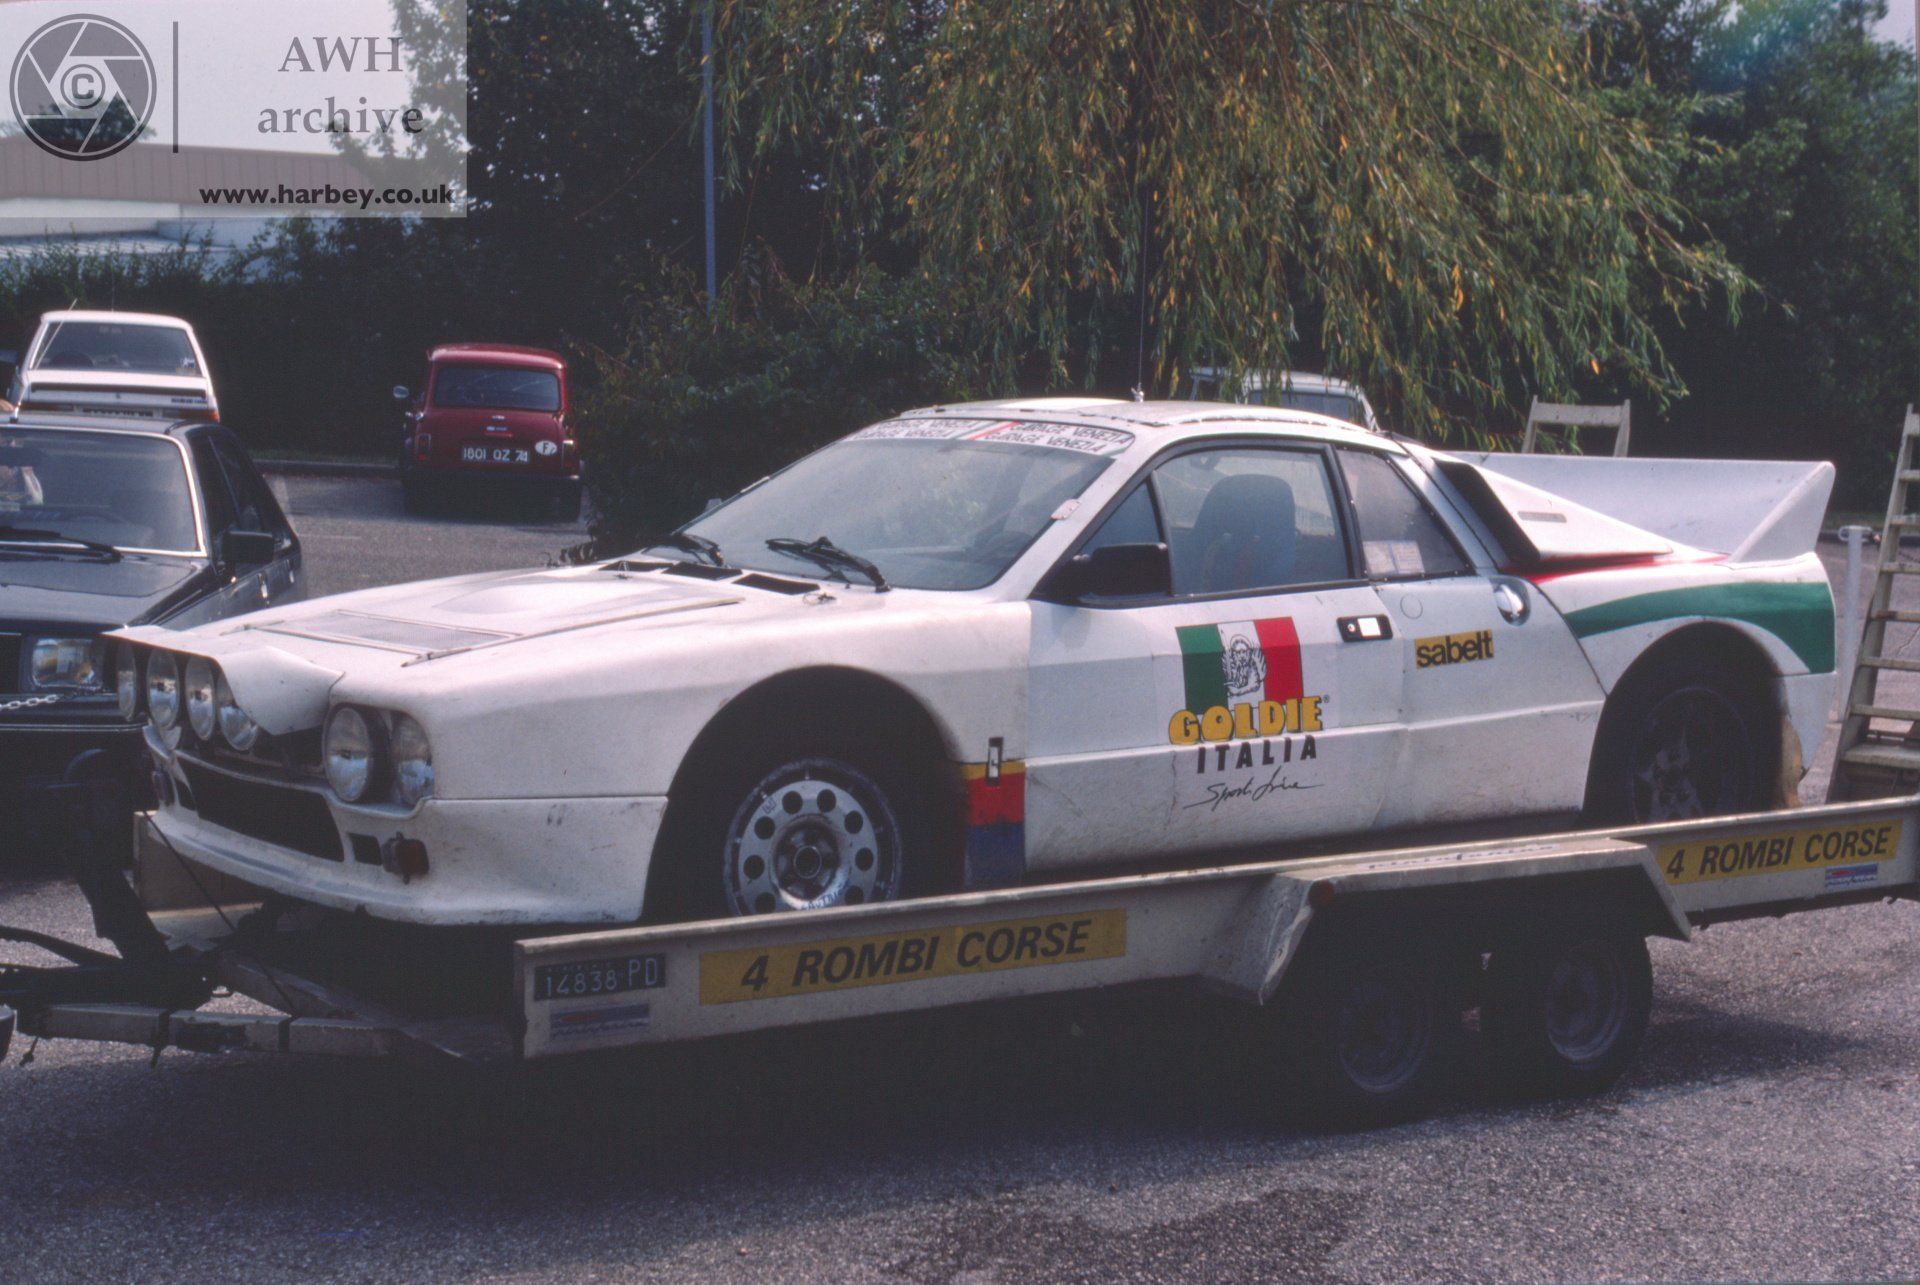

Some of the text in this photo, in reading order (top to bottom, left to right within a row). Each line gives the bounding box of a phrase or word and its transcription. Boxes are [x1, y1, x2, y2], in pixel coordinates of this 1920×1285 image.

[543, 442, 549, 454] F
[1046, 435, 1107, 453] VENEZIA
[1073, 426, 1134, 444] VENEZIA
[1416, 630, 1494, 668] sabelt
[1197, 735, 1317, 774] ITALIA
[1666, 826, 1892, 878] 4 ROMBI CORSE
[741, 919, 1092, 991] 4 ROMBI CORSE
[546, 957, 658, 997] 14838 PD
